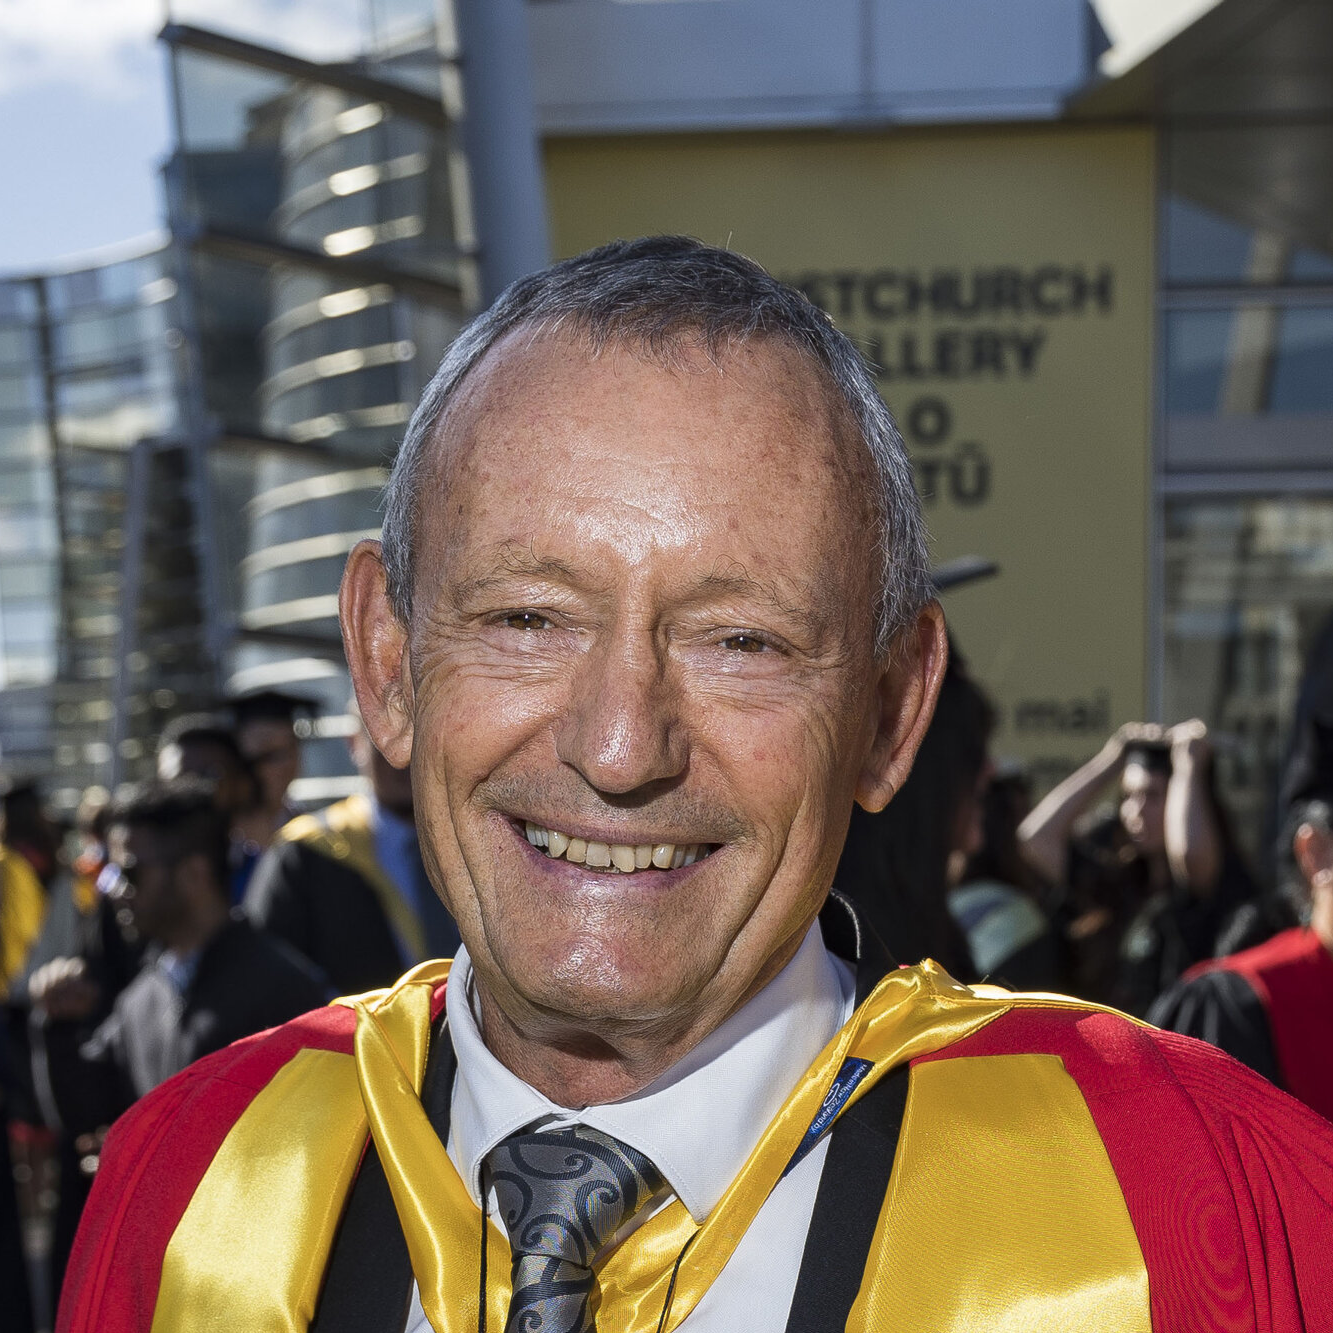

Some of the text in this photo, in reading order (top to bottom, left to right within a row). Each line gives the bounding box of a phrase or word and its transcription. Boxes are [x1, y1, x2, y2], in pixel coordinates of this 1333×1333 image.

[781, 264, 1113, 321] STCHURCH
[872, 328, 1046, 381] LLERY
[907, 395, 953, 447] O
